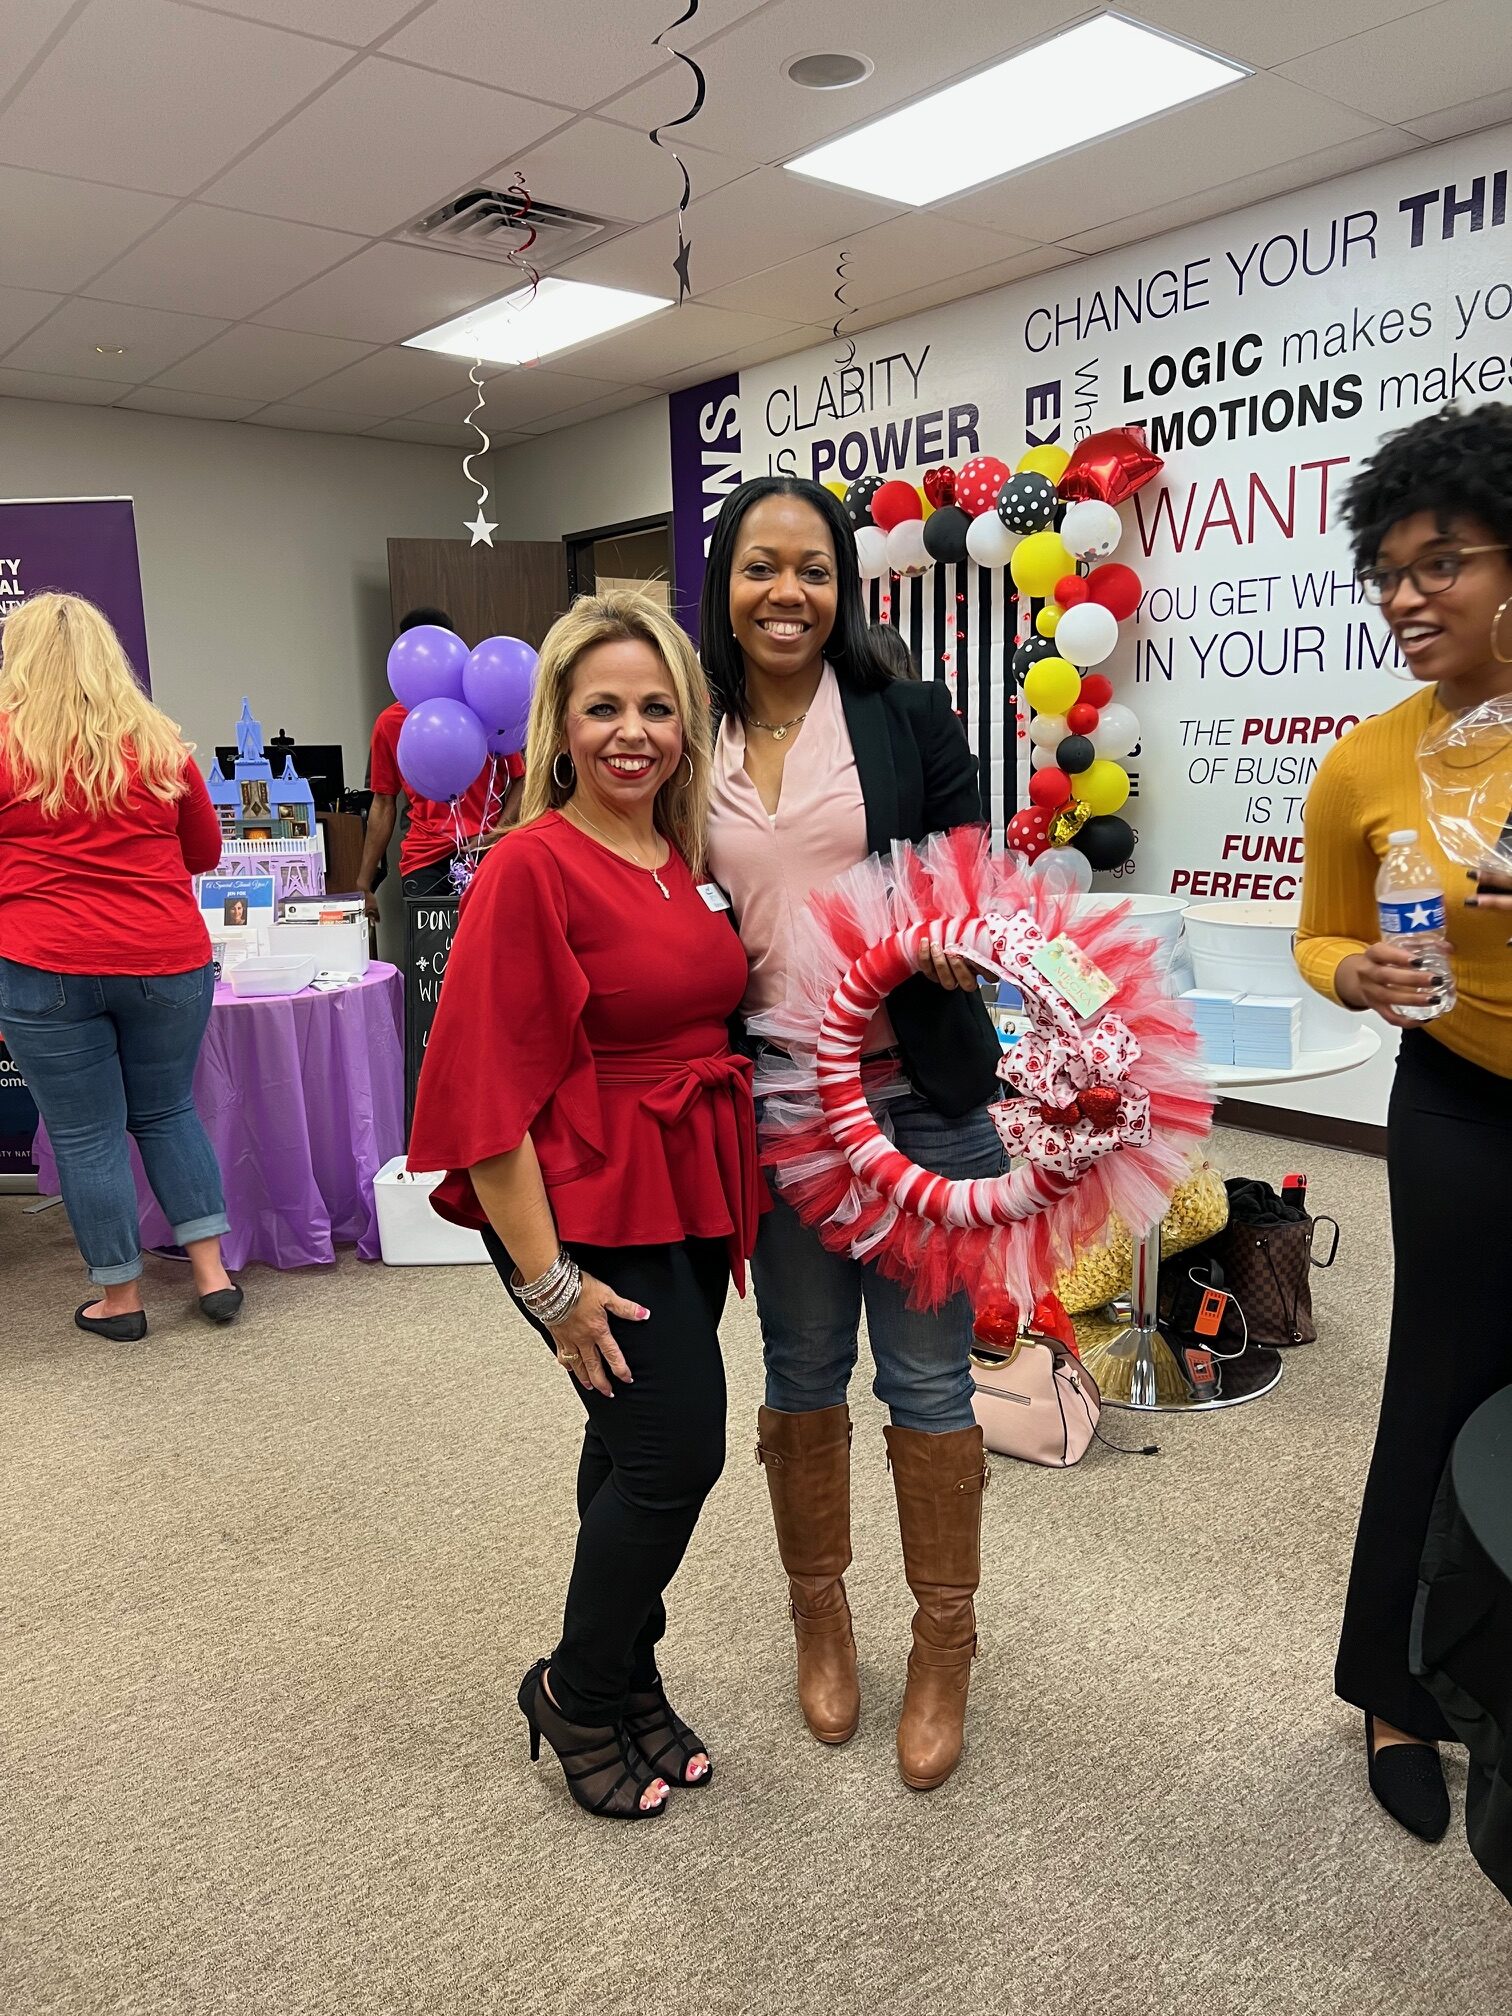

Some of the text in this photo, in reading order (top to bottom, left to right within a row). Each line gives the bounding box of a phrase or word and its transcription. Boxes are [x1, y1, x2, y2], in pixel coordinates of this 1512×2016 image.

[1025, 170, 1507, 353] CHANGE YOUR THI
[1123, 333, 1262, 404] LOGIC
[1282, 302, 1432, 367] makes
[766, 345, 930, 437] CLARITY
[1125, 374, 1363, 454] MOTIONS
[811, 403, 980, 483] POWER
[1133, 456, 1350, 557] WANT
[1136, 568, 1365, 625] YOU GET WH
[1136, 622, 1407, 683] IN YOUR IM
[1180, 719, 1235, 746] THE
[1188, 757, 1228, 784] OF
[1246, 796, 1271, 824] IS
[1222, 834, 1305, 863] FUND
[1170, 869, 1303, 900] PERFEC
